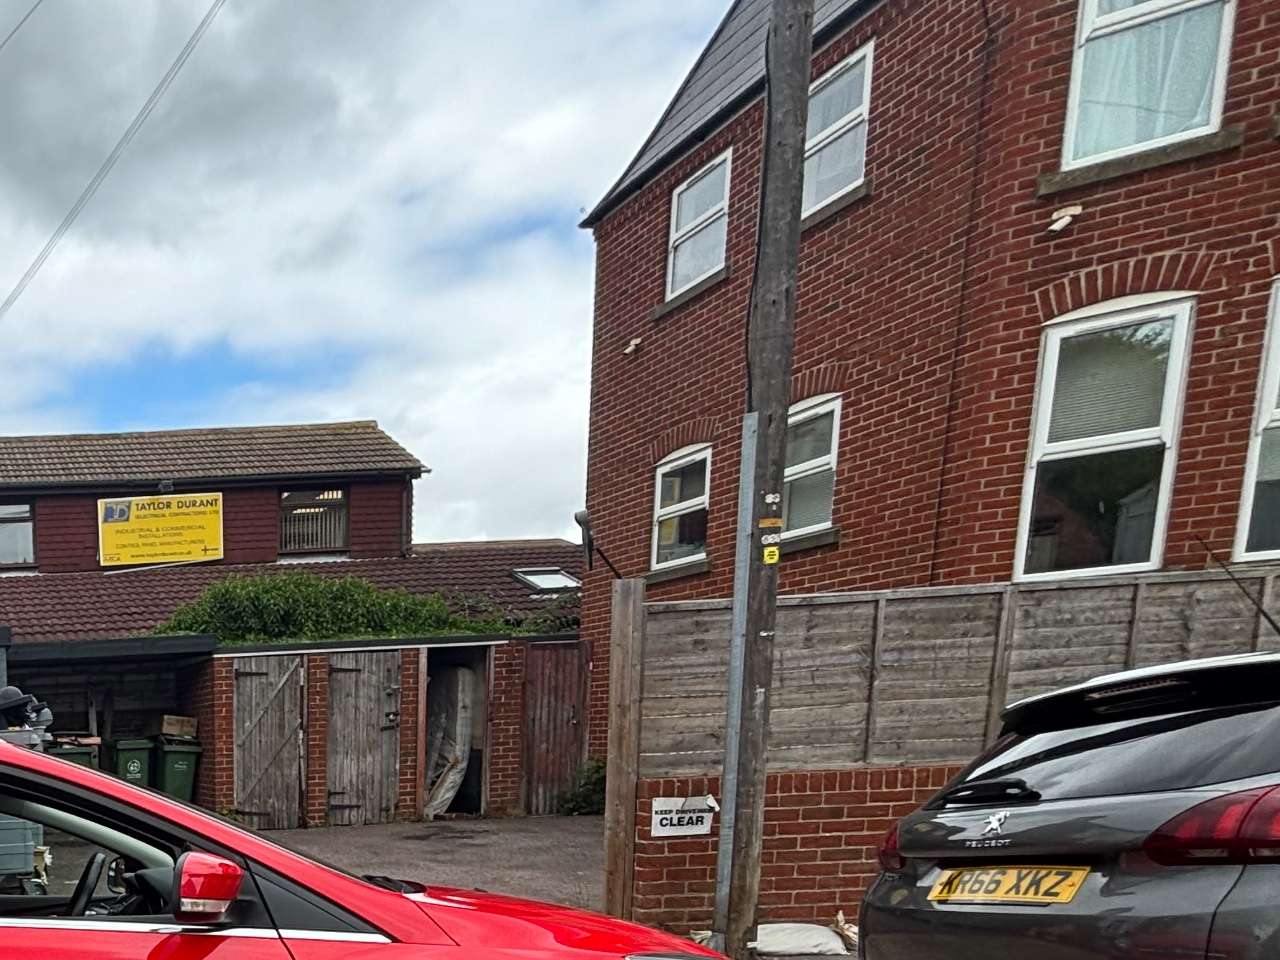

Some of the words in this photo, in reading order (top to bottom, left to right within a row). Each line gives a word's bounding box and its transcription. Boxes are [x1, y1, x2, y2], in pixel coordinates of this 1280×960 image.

[136, 501, 172, 511] TAYLOR
[177, 499, 219, 509] DURANT
[660, 815, 705, 827] CLEAR
[965, 839, 1011, 847] PEUGEOT
[940, 870, 1006, 894] KR66
[1007, 870, 1073, 896] XKZ
